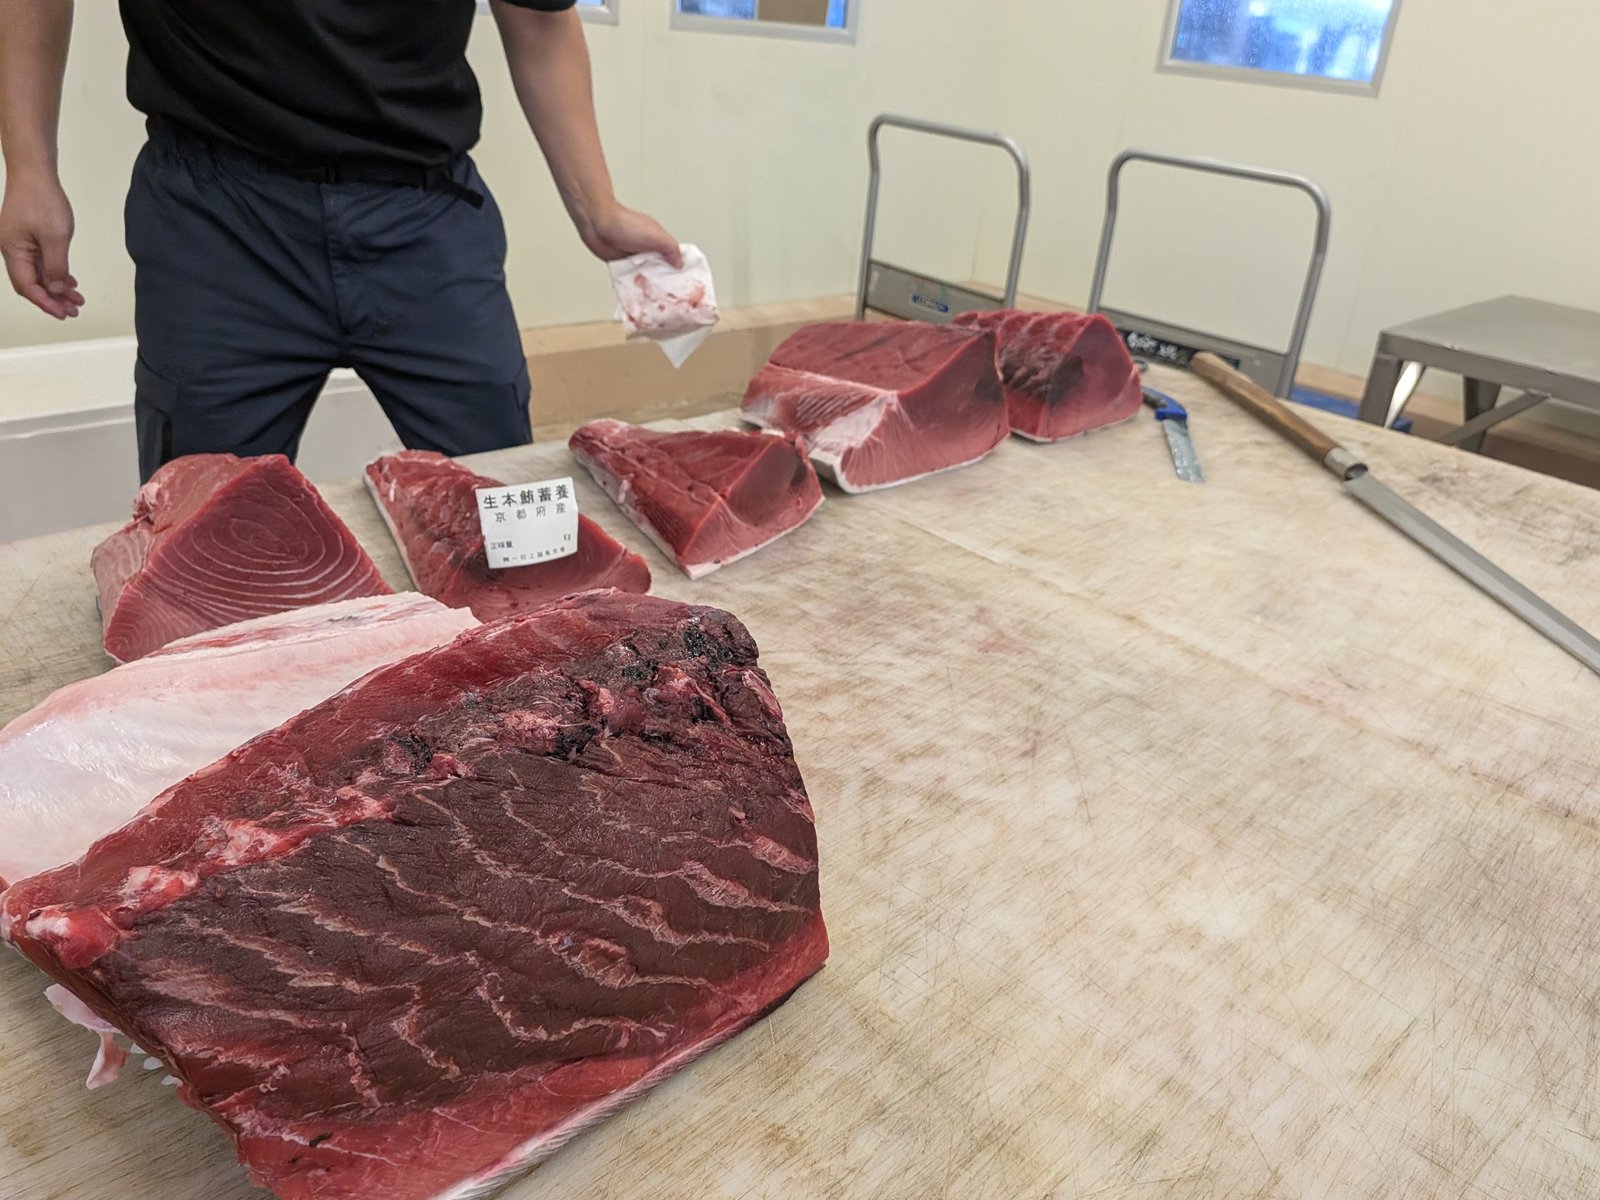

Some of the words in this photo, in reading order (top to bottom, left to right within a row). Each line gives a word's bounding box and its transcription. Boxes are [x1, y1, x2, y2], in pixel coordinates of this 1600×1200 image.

[483, 484, 569, 510] 生本鮪蓄養
[494, 502, 567, 523] 京都府産
